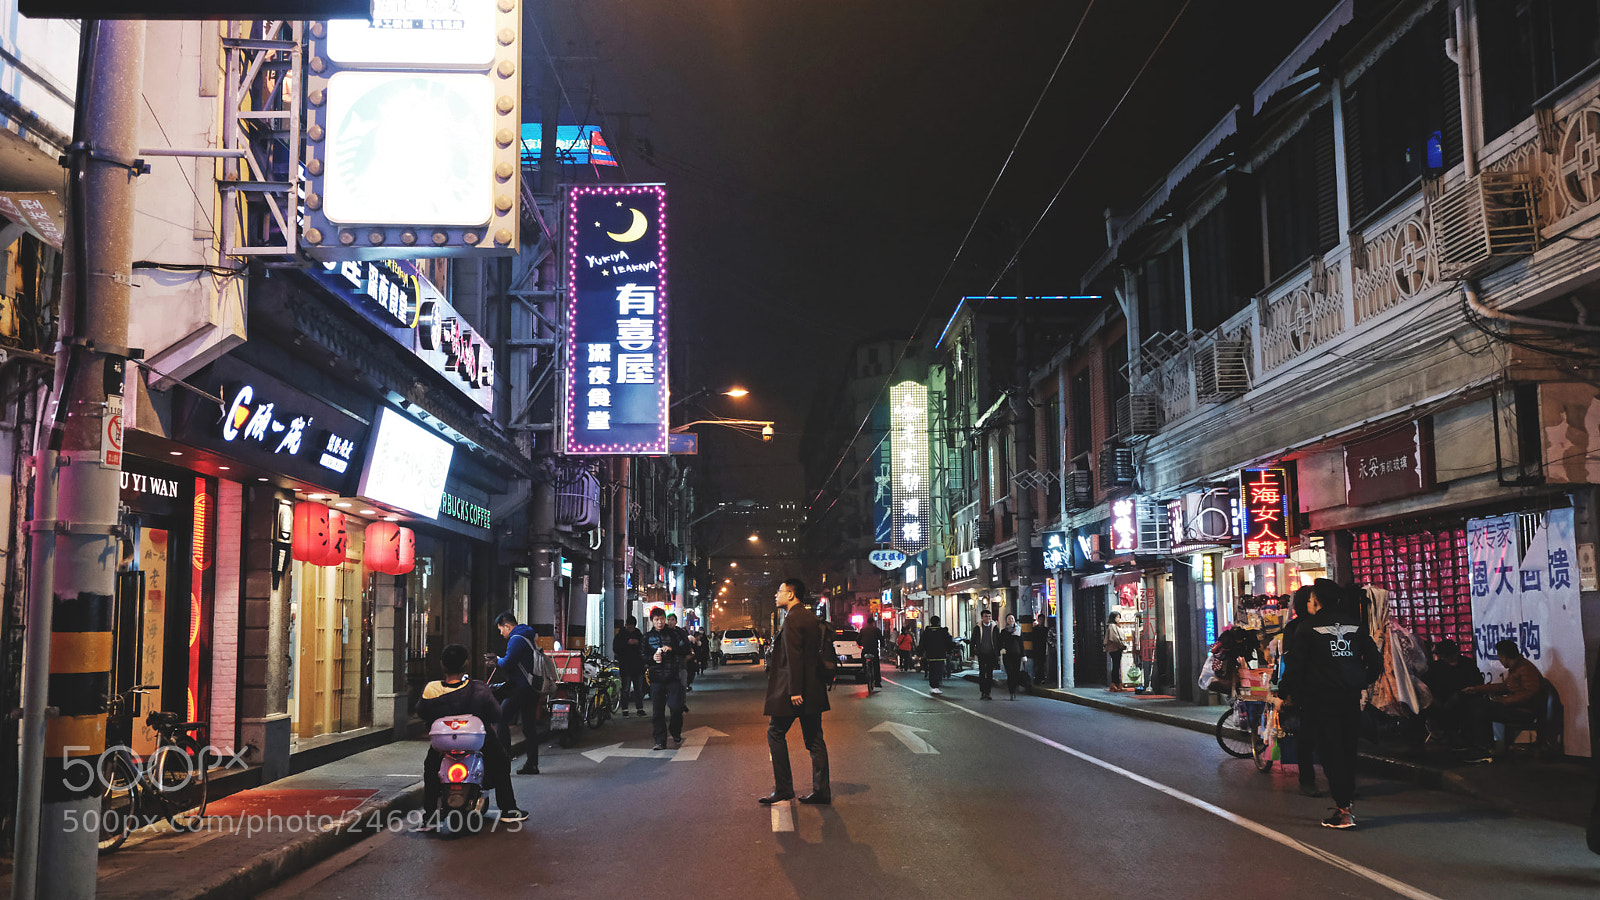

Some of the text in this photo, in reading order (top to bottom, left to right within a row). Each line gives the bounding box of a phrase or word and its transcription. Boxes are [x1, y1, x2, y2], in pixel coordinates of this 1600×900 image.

[585, 250, 630, 268] YUKIYA
[615, 282, 657, 385] 有喜屋
[587, 343, 611, 431] 深夜食堂
[132, 473, 147, 492] YI
[149, 477, 178, 498] WAN
[469, 503, 491, 529] COFFEE
[1248, 469, 1281, 540] 上海女人
[1247, 541, 1288, 556] 雪花膏
[1468, 521, 1513, 550] 衣专家
[1472, 547, 1571, 598] 恩大回馈
[1330, 640, 1351, 651] BOY
